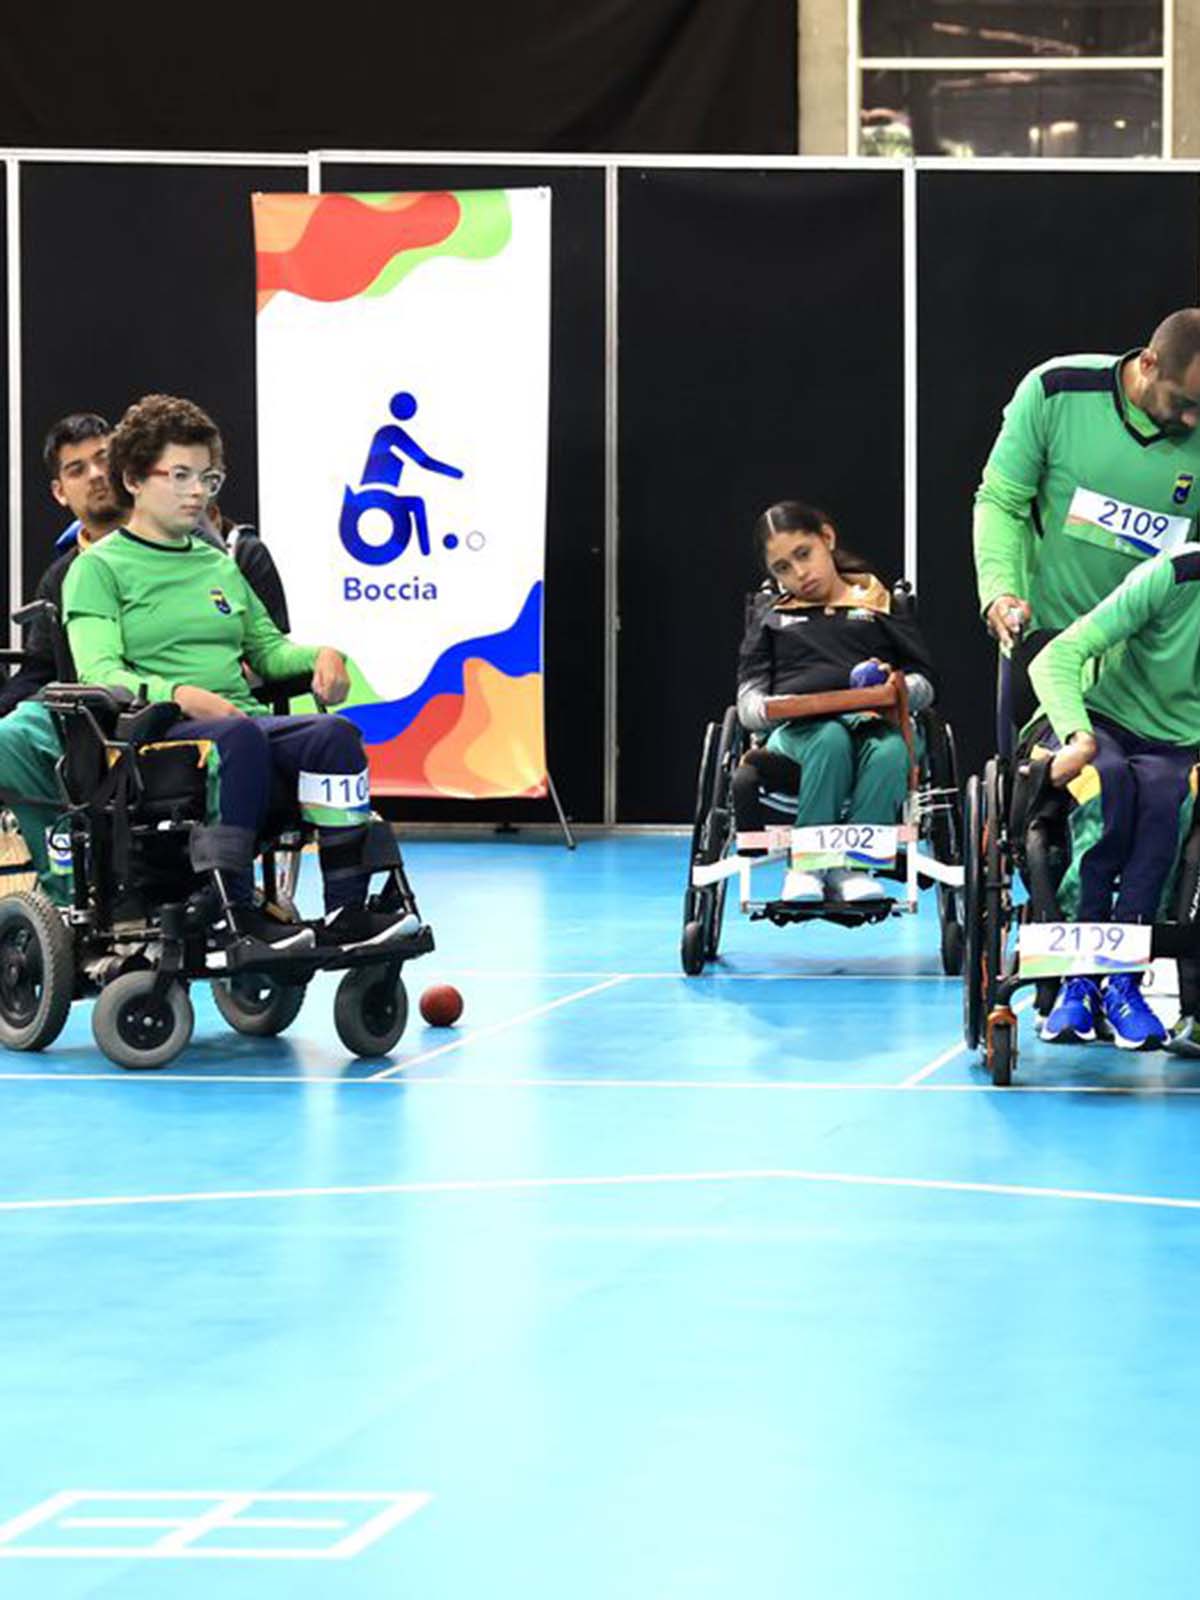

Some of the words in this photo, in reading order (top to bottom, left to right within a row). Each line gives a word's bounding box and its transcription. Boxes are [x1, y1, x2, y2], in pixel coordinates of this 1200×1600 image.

[1098, 501, 1169, 539] 2109
[344, 576, 437, 601] Boccia
[816, 826, 875, 850] 1202
